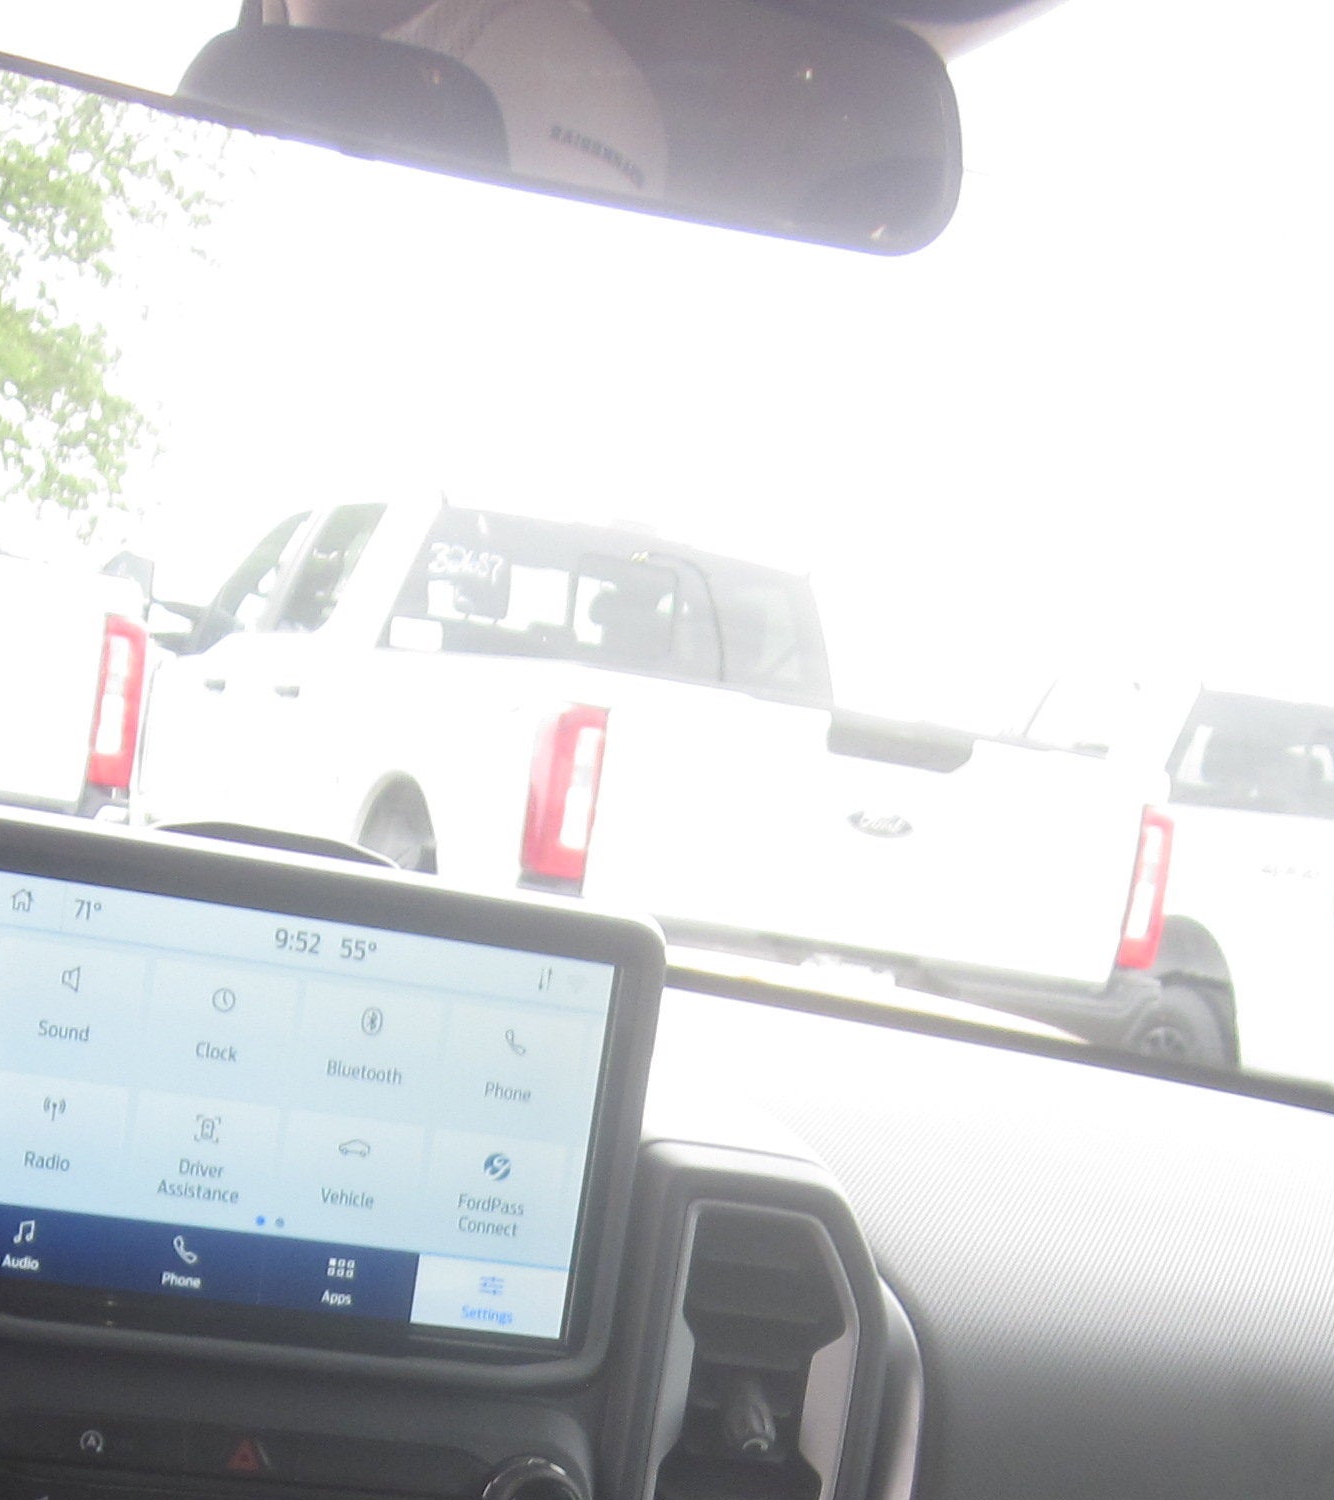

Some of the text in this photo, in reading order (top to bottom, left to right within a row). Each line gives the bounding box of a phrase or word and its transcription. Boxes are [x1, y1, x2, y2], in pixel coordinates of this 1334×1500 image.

[275, 928, 378, 961] 9:52 55°
[38, 1019, 91, 1042] Sound
[195, 1041, 237, 1063] Clock
[326, 1059, 403, 1085] Bluetooth
[484, 1081, 532, 1102] Phone
[23, 1151, 71, 1172] Radio
[178, 1158, 224, 1179] Driver
[157, 1179, 240, 1204] Assistance
[320, 1186, 375, 1210] Vehicle
[457, 1192, 524, 1216] FordPass
[457, 1216, 518, 1237] Connect
[1, 1253, 40, 1271] Audio
[161, 1271, 201, 1289] Phone
[320, 1289, 353, 1307] Apps
[461, 1304, 514, 1326] Settings
